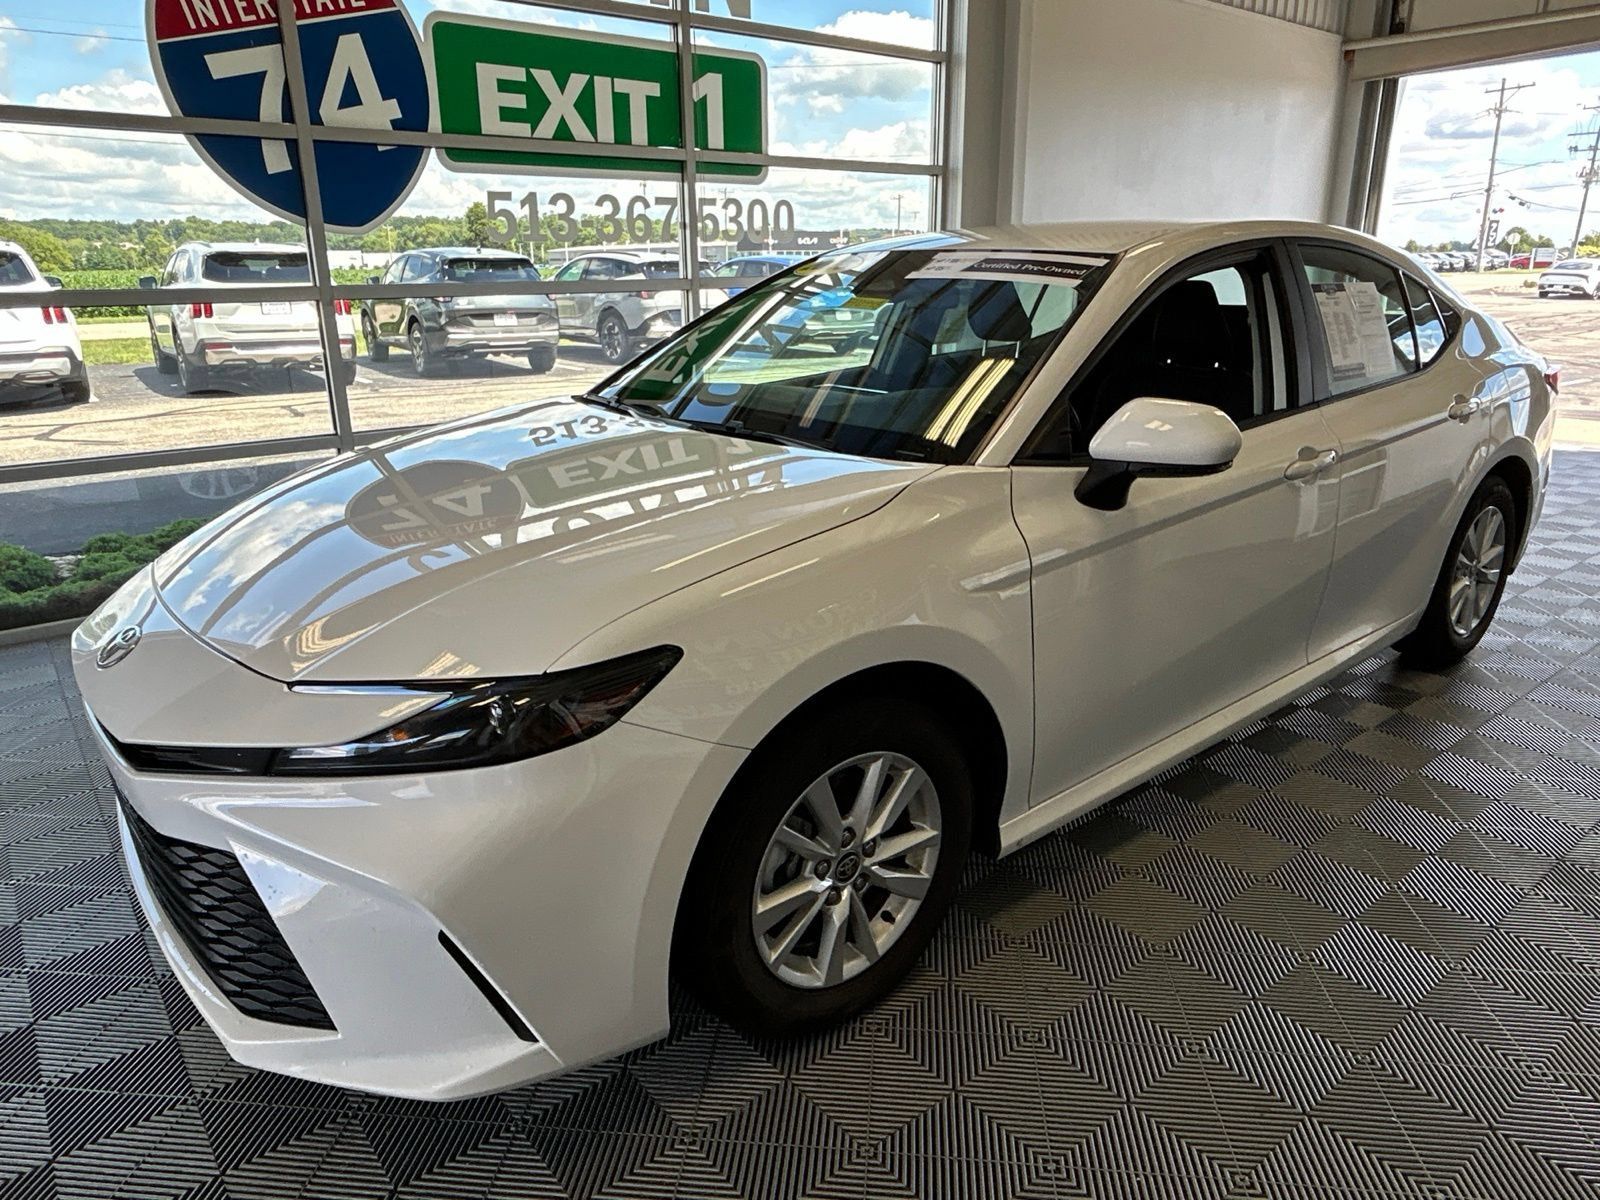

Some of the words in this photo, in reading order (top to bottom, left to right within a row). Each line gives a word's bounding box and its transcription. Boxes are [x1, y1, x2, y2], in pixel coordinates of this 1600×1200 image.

[181, 0, 366, 30] INTER
[203, 33, 402, 174] 74
[475, 62, 661, 146] EXIT
[692, 72, 724, 150] 1
[974, 261, 1021, 271] Certified
[1022, 263, 1087, 276] Pre-Owned
